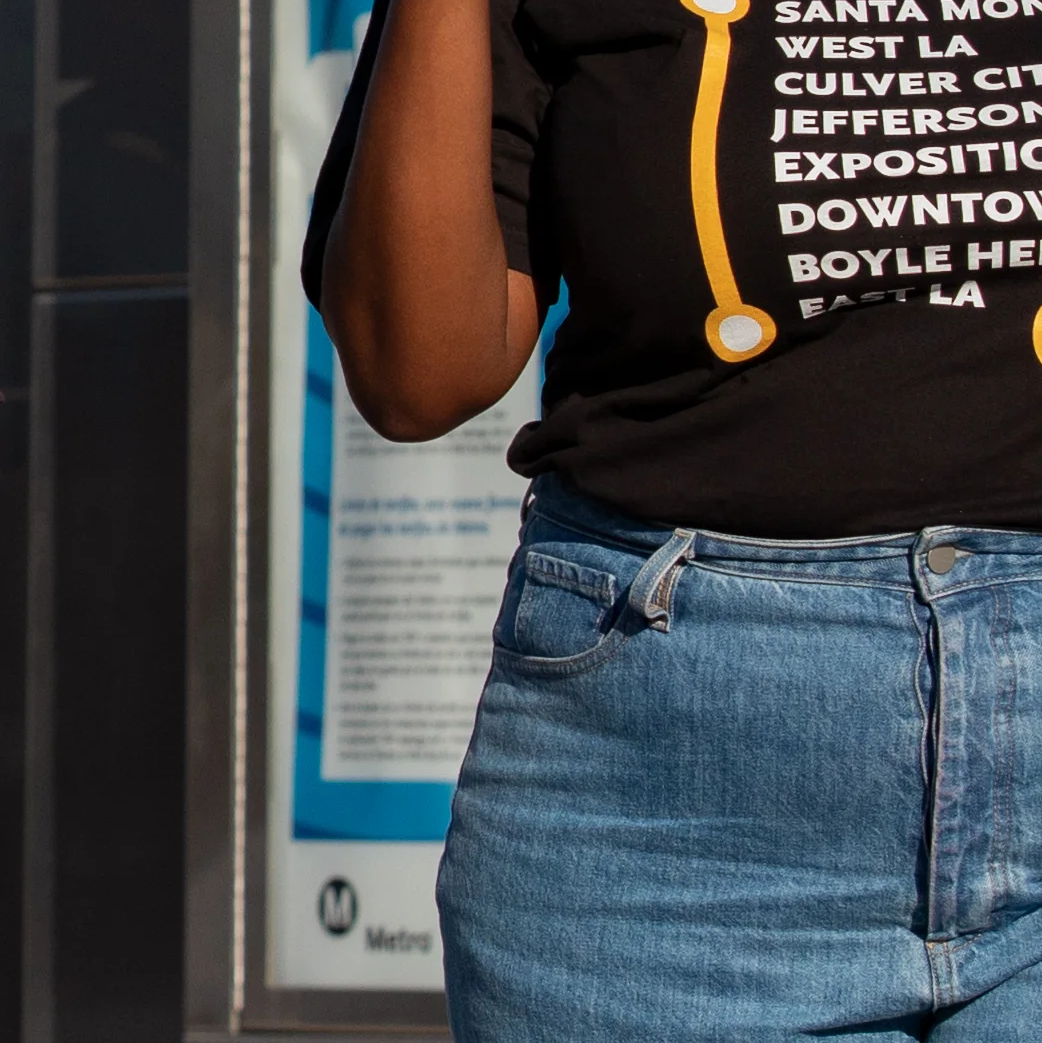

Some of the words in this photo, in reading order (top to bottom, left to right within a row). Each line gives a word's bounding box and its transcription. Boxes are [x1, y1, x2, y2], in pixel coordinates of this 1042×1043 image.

[775, 35, 904, 60] WEST
[918, 34, 978, 59] LA
[773, 71, 962, 96] CULVER
[787, 244, 952, 283] BOYLE
[928, 280, 986, 308] LA
